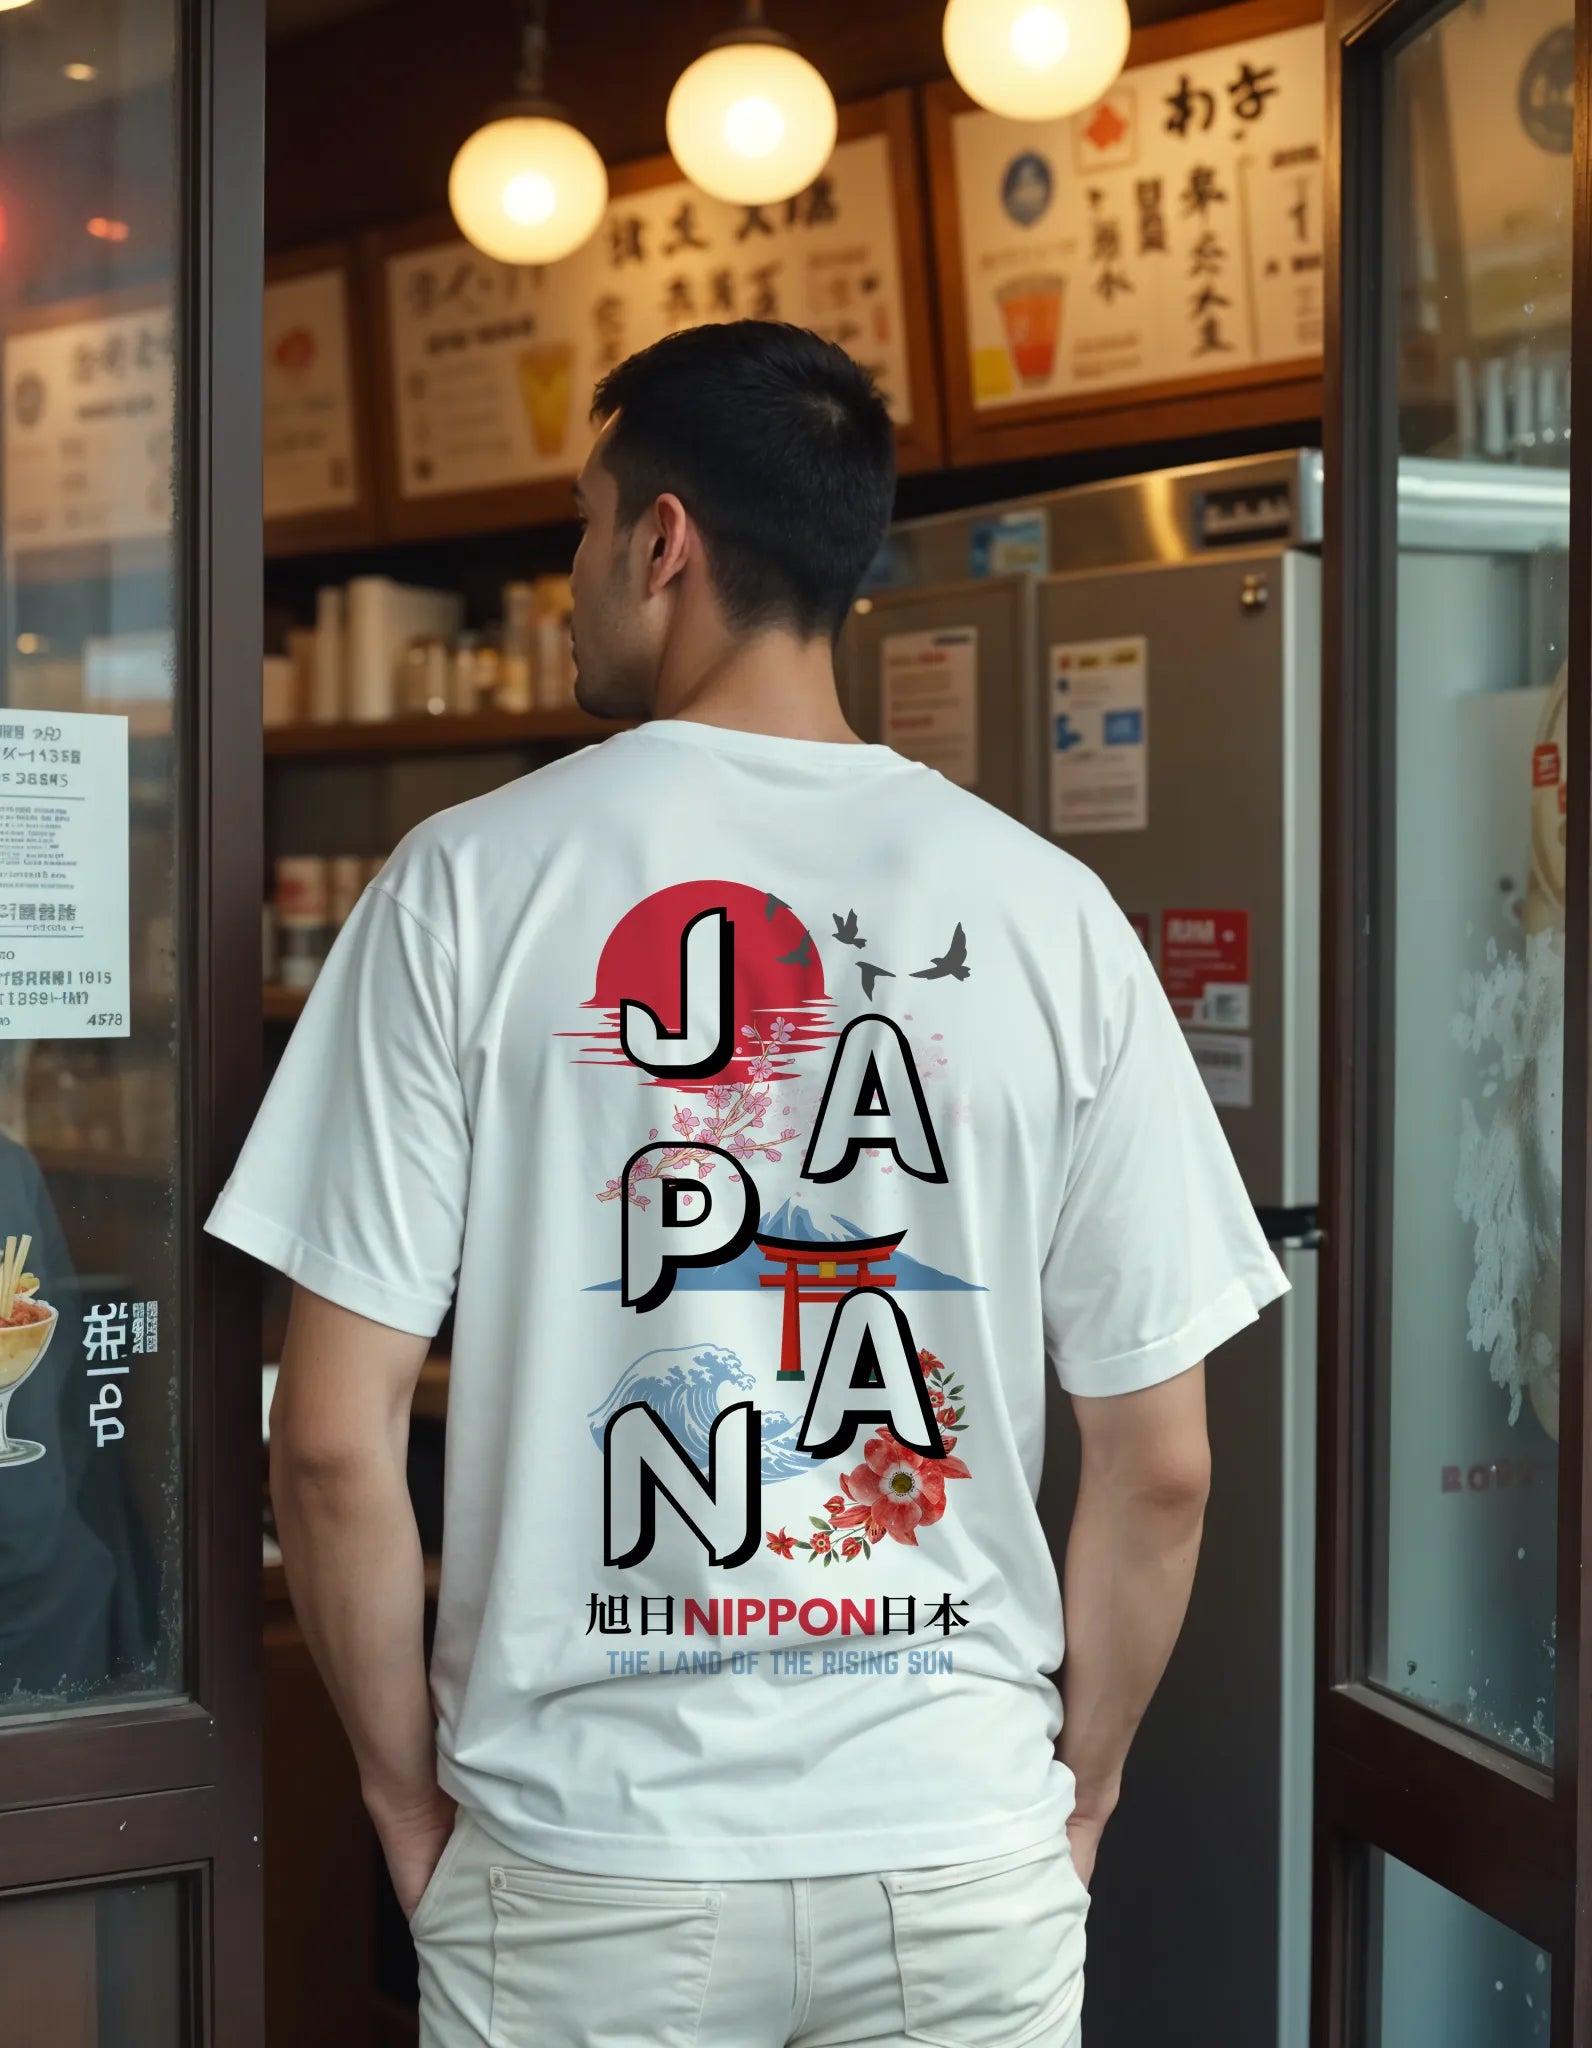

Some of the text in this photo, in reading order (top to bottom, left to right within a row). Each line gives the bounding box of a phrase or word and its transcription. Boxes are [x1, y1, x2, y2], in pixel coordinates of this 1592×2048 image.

[685, 1597, 875, 1636] NIPPON
[606, 1650, 953, 1676] THE LAND OF THE RISING SUN
